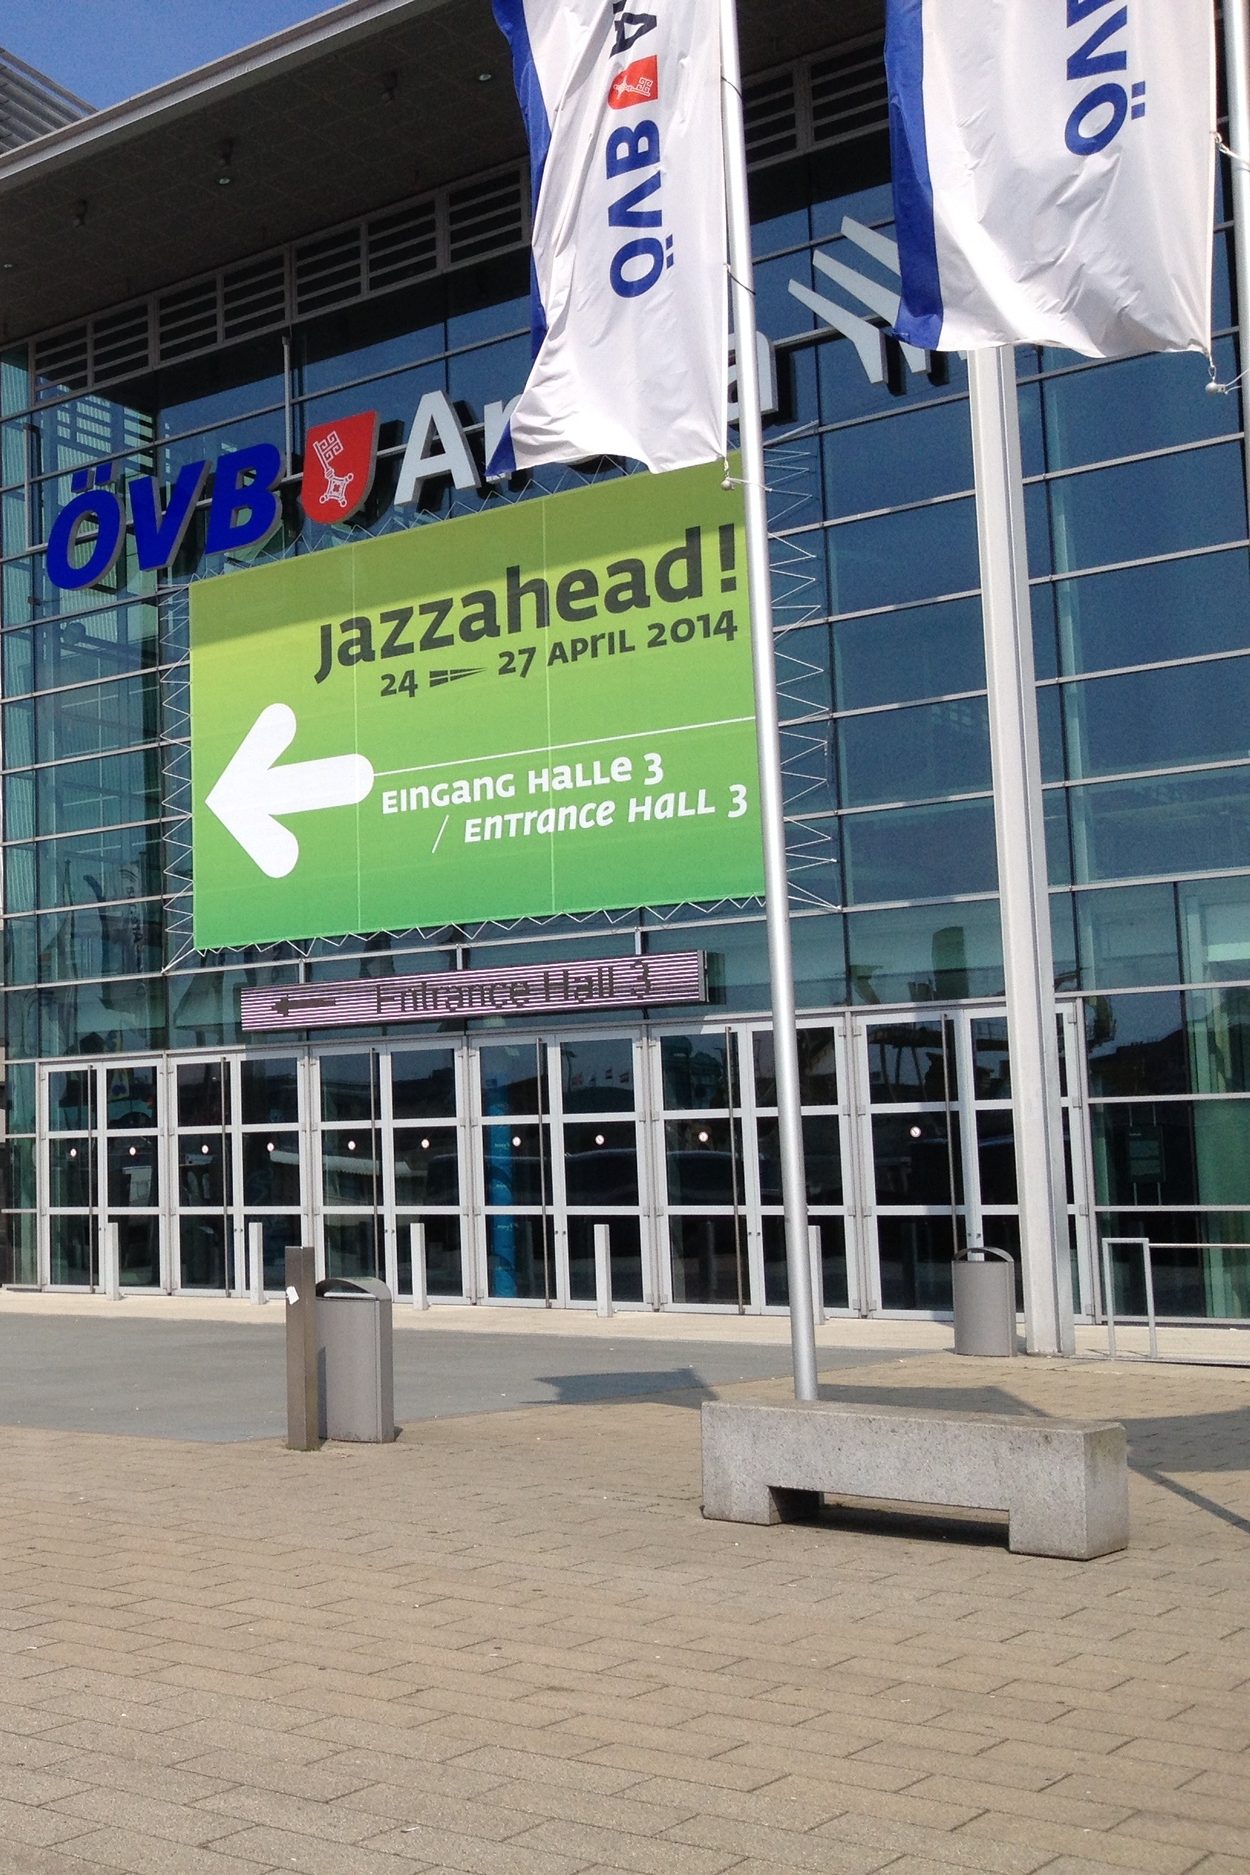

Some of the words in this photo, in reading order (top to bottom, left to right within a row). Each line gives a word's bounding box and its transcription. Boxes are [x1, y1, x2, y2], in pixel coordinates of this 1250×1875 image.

[608, 0, 658, 58] A
[1065, 0, 1146, 156] ÖV
[606, 119, 675, 299] ÖVB
[46, 442, 283, 592] ÖVB
[380, 669, 419, 698] 24
[498, 646, 538, 679] 27
[647, 609, 739, 650] 2014
[643, 752, 665, 786] 3
[727, 784, 749, 819] 3
[376, 980, 531, 1014] Entrance
[543, 966, 614, 1002] Hall
